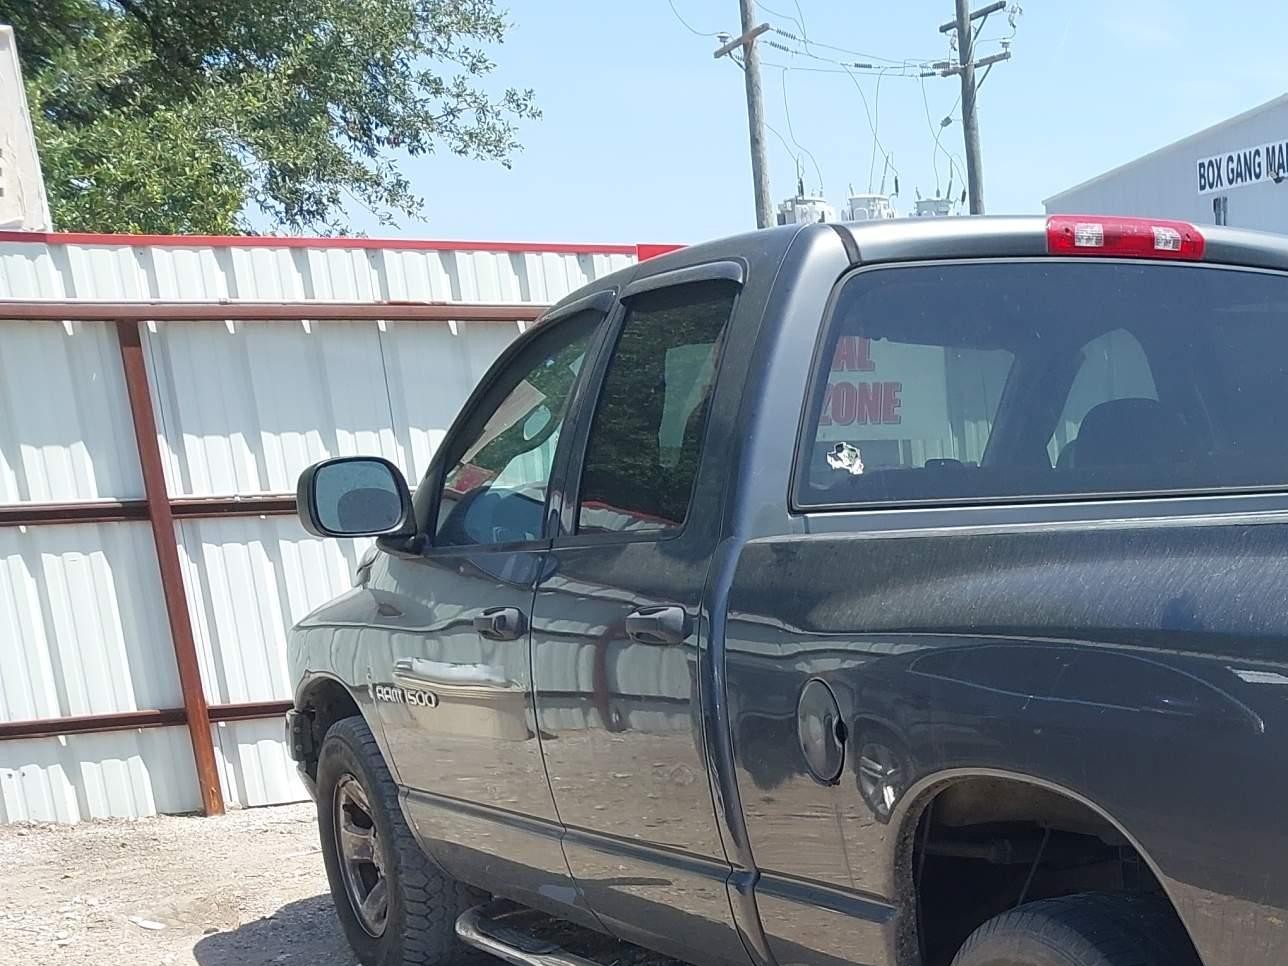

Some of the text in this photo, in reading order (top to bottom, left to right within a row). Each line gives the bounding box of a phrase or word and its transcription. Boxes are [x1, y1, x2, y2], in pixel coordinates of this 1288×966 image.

[1199, 160, 1223, 192] BOX
[1226, 148, 1262, 186] GANG
[376, 685, 437, 708] RAM 1500
